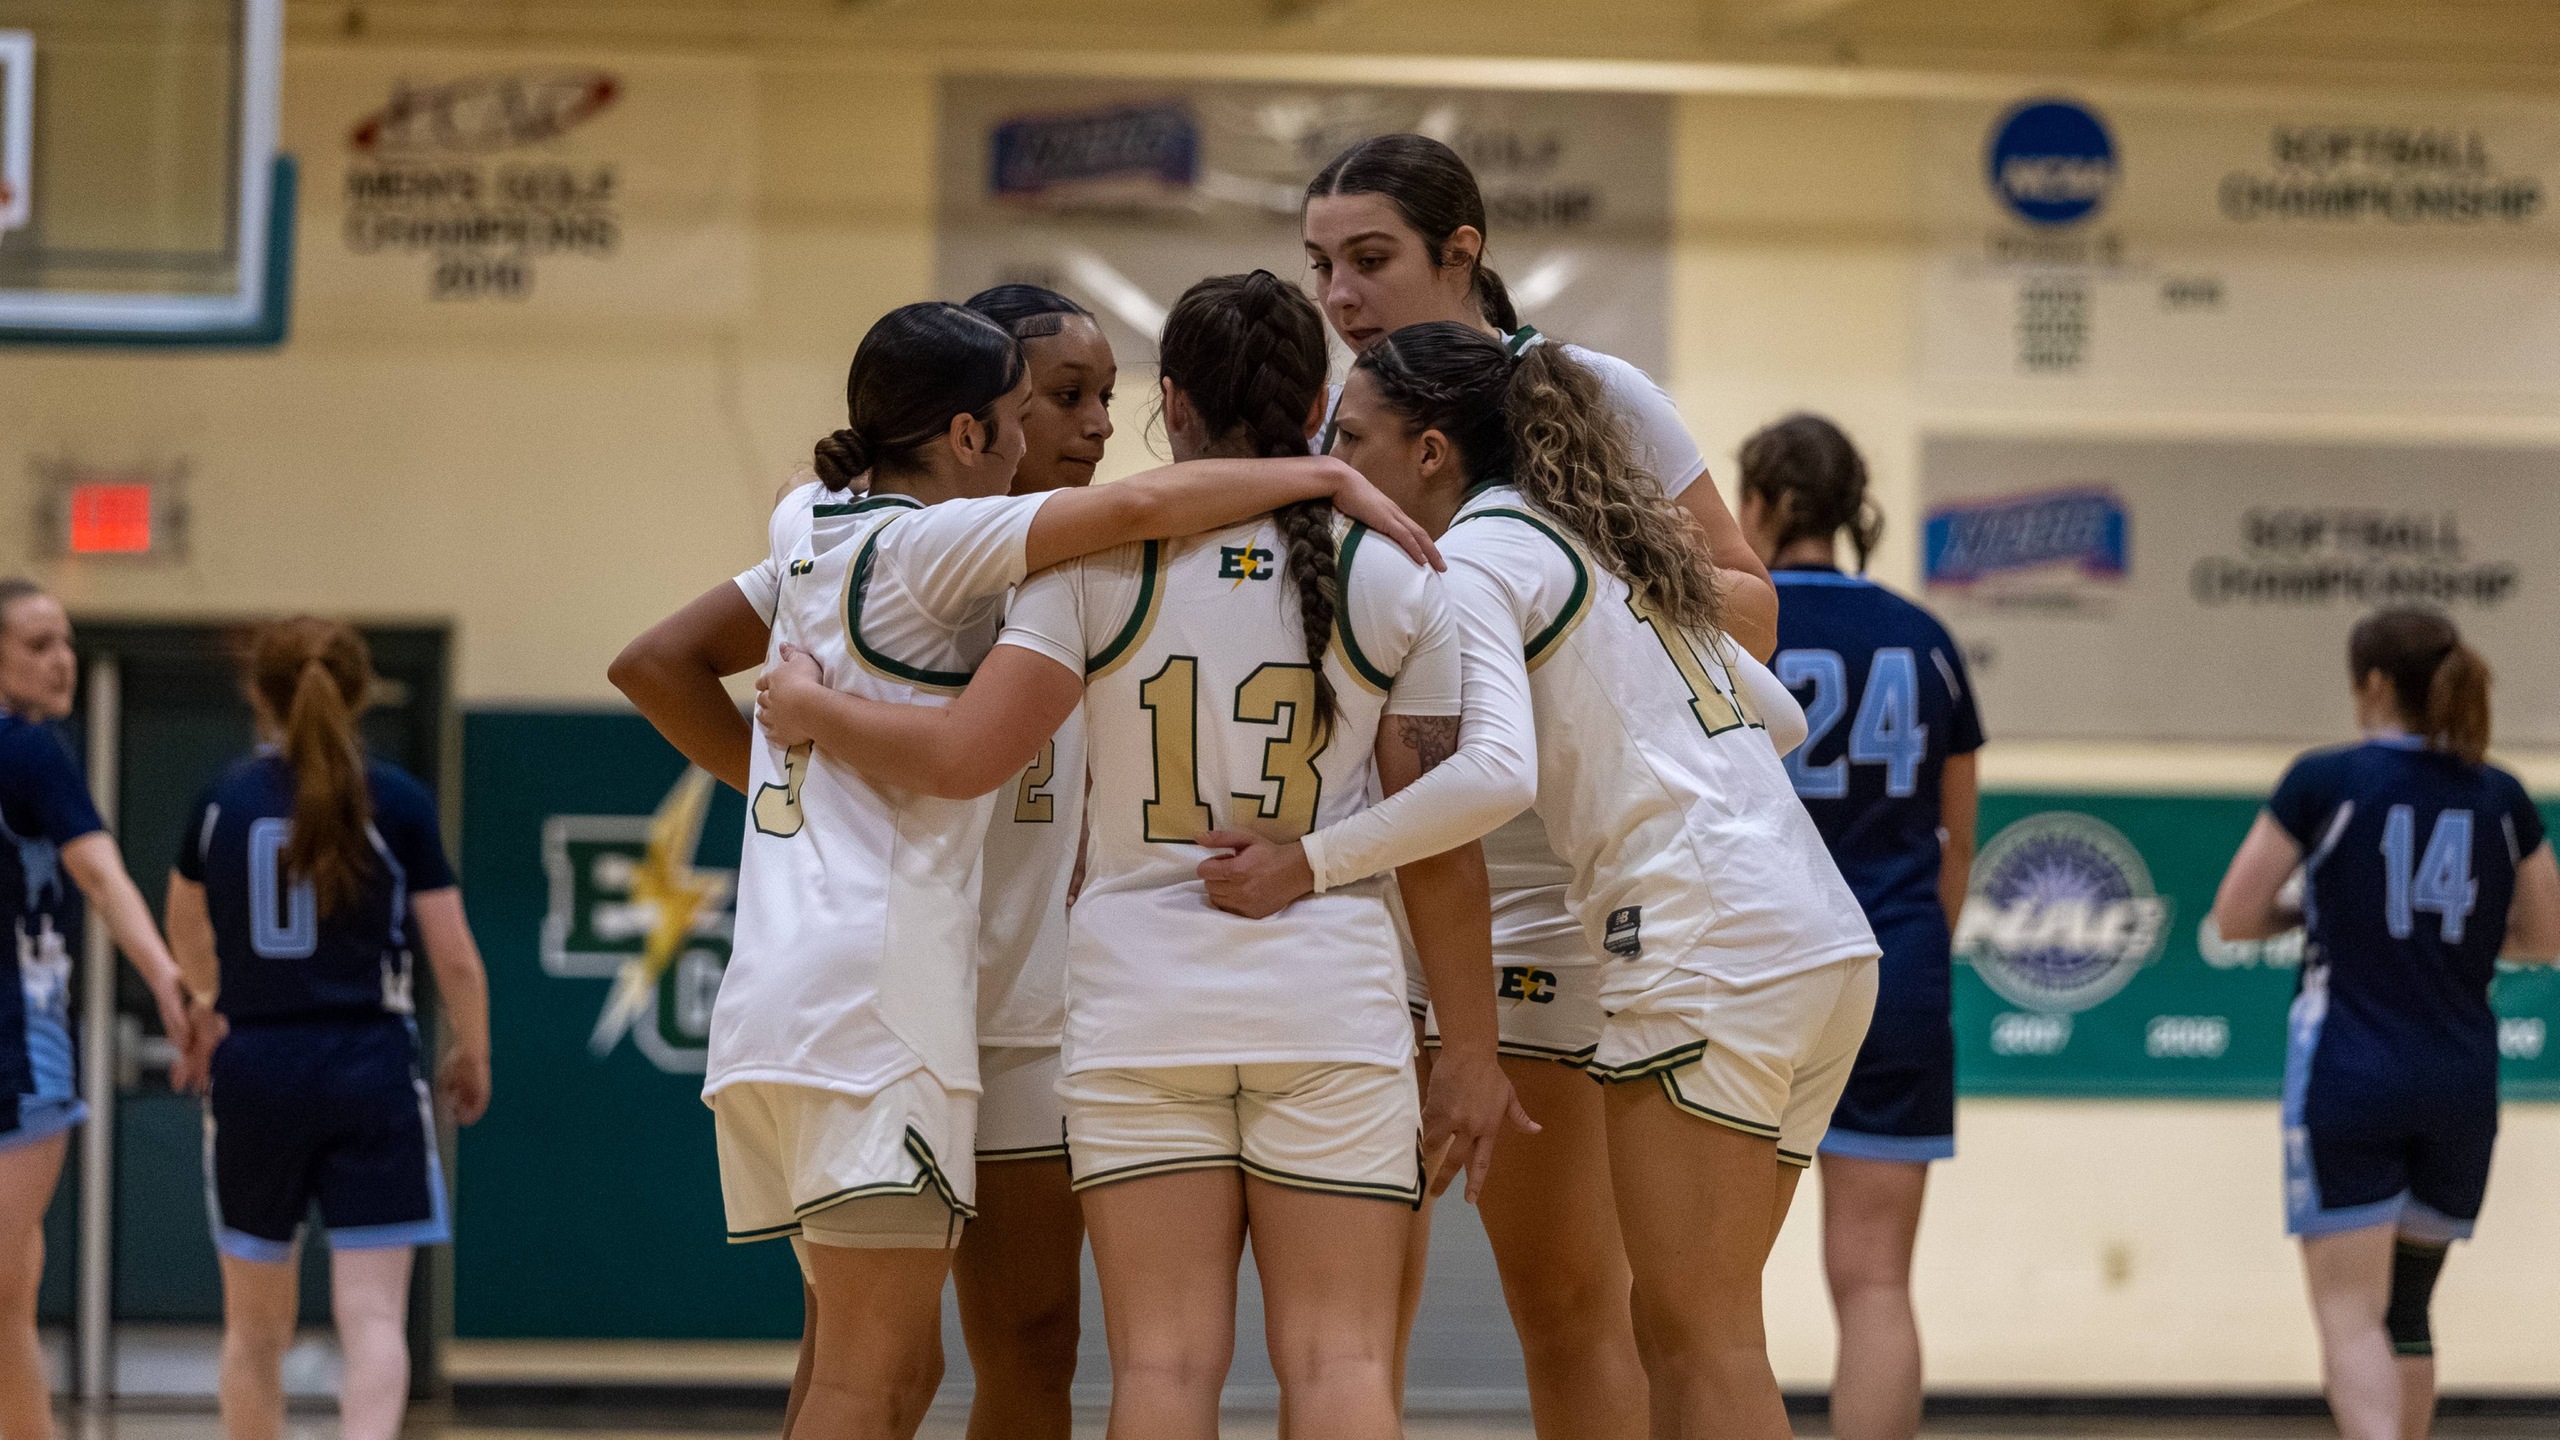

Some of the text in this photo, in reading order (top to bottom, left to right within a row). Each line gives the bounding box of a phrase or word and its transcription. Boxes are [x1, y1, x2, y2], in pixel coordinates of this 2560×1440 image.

[2272, 124, 2490, 171] SOFTBALL
[497, 166, 616, 203] GOLF
[2219, 174, 2542, 222] CHAMPIONSHIP
[345, 214, 618, 252] CHAMPIONS
[2241, 506, 2462, 553] SOFTBALL
[1218, 545, 1274, 581] EC
[2190, 558, 2518, 604] CHAMPIONSHIP
[1777, 647, 1928, 798] 24
[1140, 654, 1338, 846] 13
[247, 816, 318, 960] 0
[2380, 803, 2477, 942] 14
[1498, 966, 1557, 1004] EC
